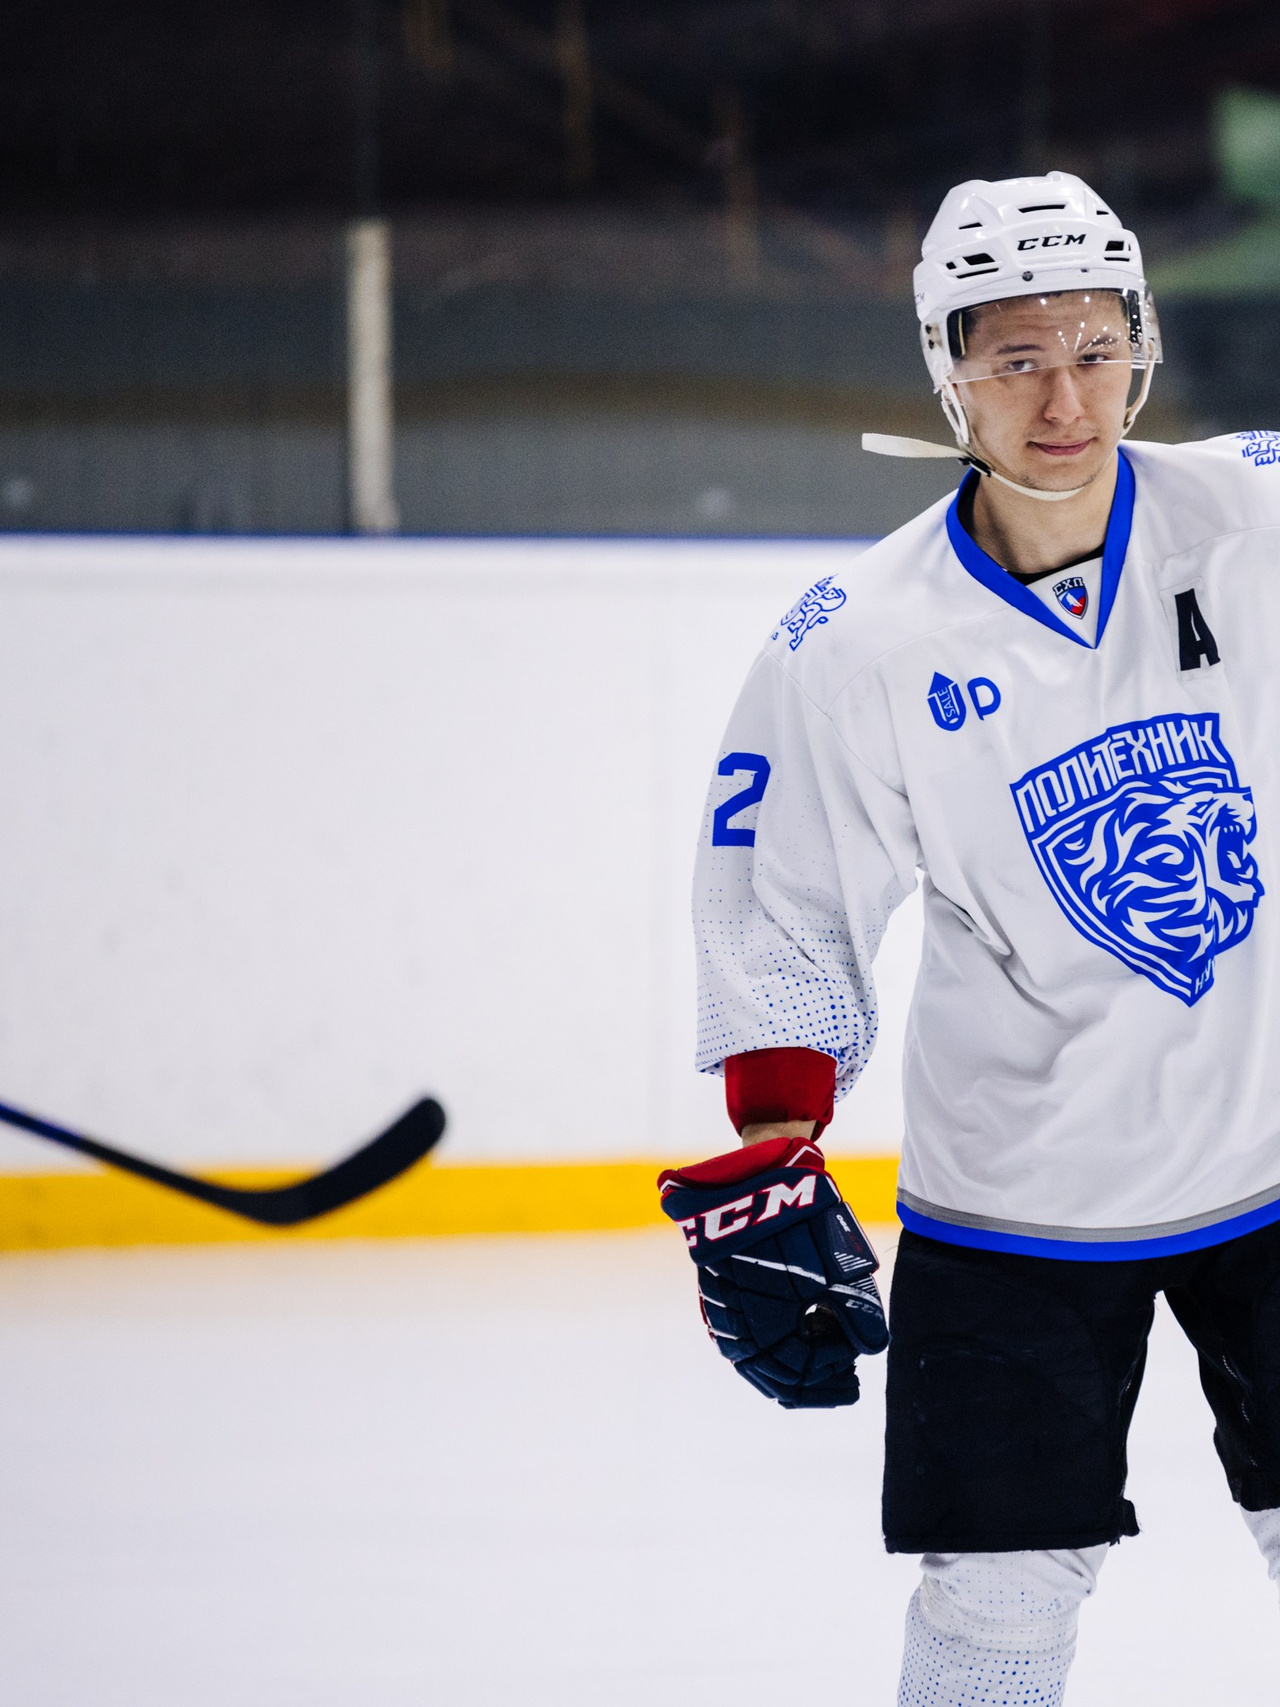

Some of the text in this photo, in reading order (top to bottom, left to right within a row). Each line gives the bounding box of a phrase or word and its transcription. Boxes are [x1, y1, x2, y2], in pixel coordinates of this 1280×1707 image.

[1017, 233, 1086, 251] CCM
[1174, 588, 1221, 671] A
[937, 686, 957, 718] SALE
[1015, 719, 1229, 834] ПОЛИТЕХНИК
[674, 1174, 817, 1248] CCM
